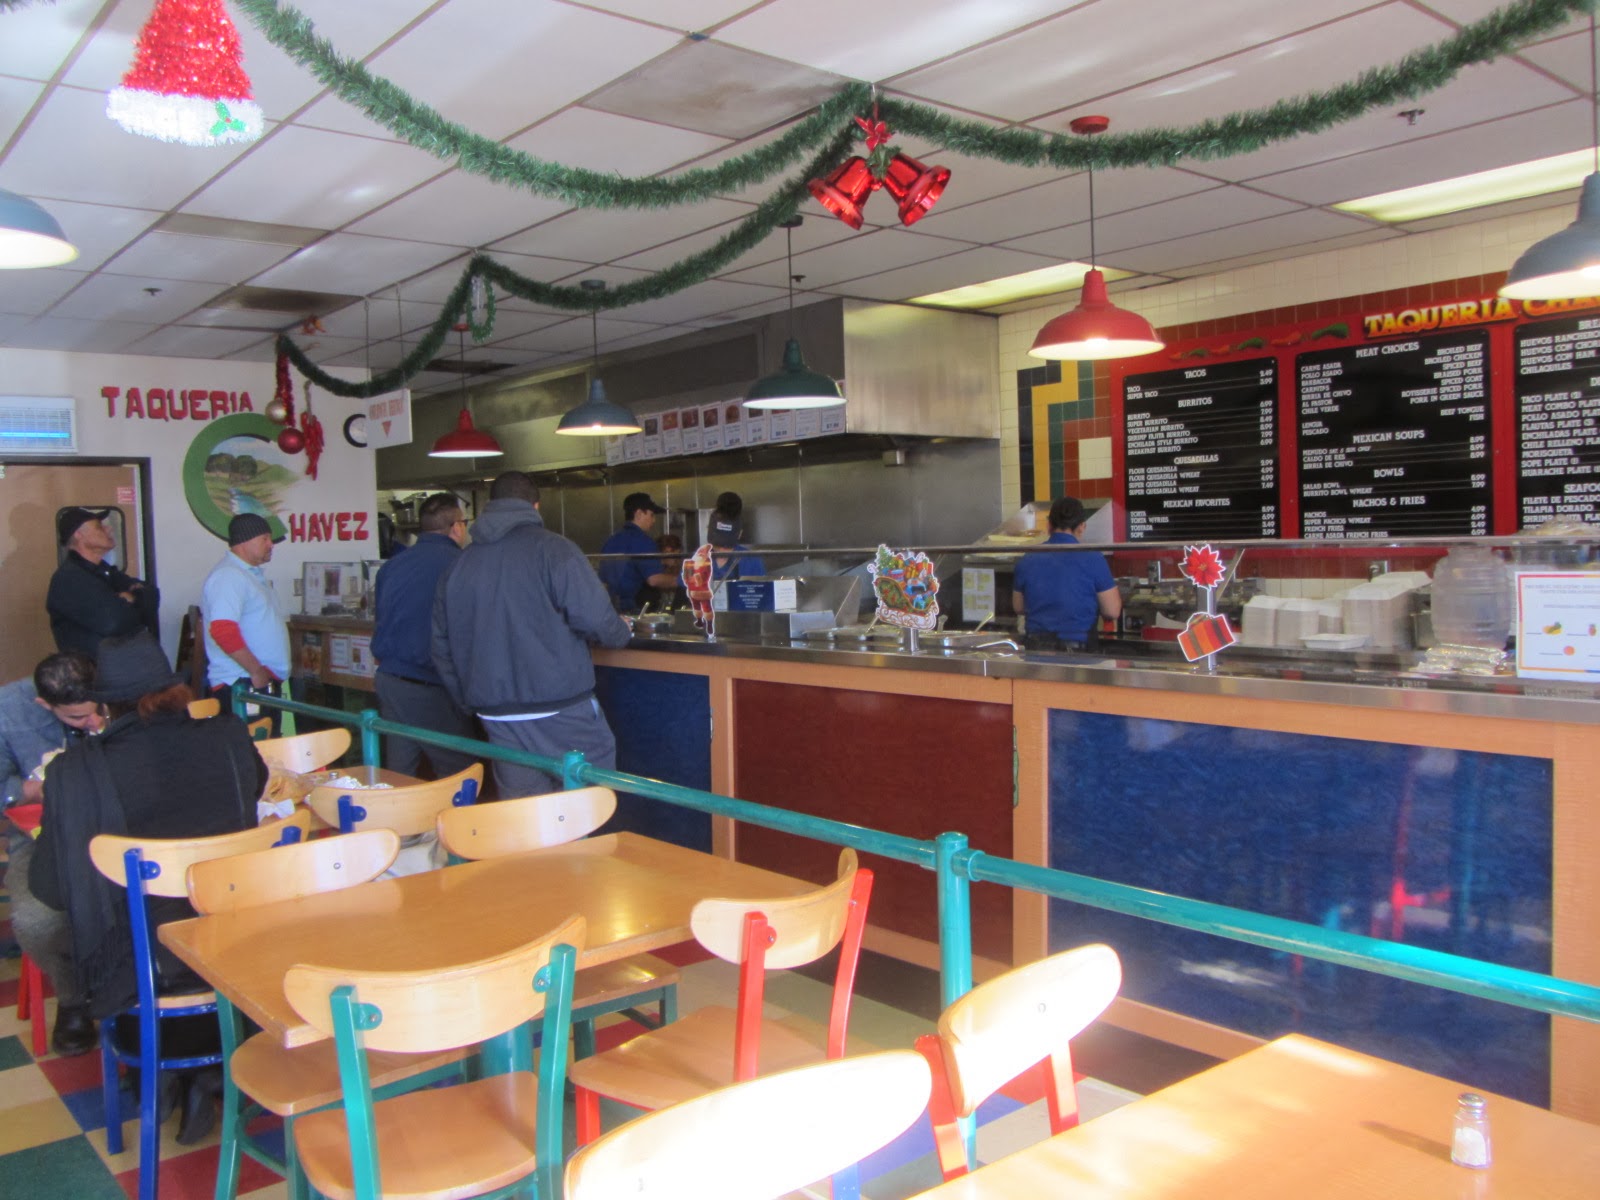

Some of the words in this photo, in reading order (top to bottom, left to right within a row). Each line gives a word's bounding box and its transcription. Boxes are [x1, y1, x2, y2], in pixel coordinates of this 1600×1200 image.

[1365, 297, 1518, 338] TAQUERIA
[1521, 336, 1553, 347] HUEVOS
[1356, 348, 1379, 358] MEAT
[1382, 342, 1419, 354] CHOICES
[1437, 346, 1464, 355] BROILED
[1467, 344, 1482, 352] BEEF
[1521, 346, 1553, 356] HUEVOS
[1555, 343, 1573, 352] CON
[1425, 355, 1451, 365] BROILED
[1453, 352, 1482, 362] CHICKEN
[1521, 355, 1553, 366] HUEVOS
[1555, 353, 1573, 361] CON
[1576, 350, 1596, 359] HAM
[1301, 364, 1320, 372] CARNE
[1322, 362, 1341, 370] ASADA
[1442, 362, 1465, 370] SPICED
[1521, 362, 1572, 375] CHILAQUILES
[1184, 369, 1206, 378] TACOS
[1301, 371, 1320, 379] POLLO
[1322, 369, 1342, 377] ASADO
[1433, 370, 1461, 379] BRAISED
[1463, 368, 1482, 376] PORK
[1302, 378, 1332, 387] BARBACOA
[1441, 377, 1463, 386] SPICED
[1465, 375, 1483, 383] GOAT
[1302, 392, 1321, 401] BIRRIA
[1333, 389, 1352, 397] CHIVO
[1402, 388, 1437, 398] ROTISSERIE
[1440, 385, 1462, 393] SPICED
[1463, 383, 1483, 391] PORK
[1178, 397, 1212, 408] BURRITOS
[1410, 396, 1428, 404] PORK
[1439, 393, 1461, 401] GREEN
[1463, 391, 1483, 399] SAUCE
[1521, 395, 1542, 403] TACO
[1544, 392, 1568, 402] PLATE
[101, 386, 253, 422] TAQUERIA
[1311, 399, 1332, 407] PASTOR
[1522, 404, 1542, 413] MEAT
[1545, 401, 1576, 411] COMBO
[1302, 406, 1318, 415] CHILE
[1440, 408, 1456, 416] BEEF
[1458, 406, 1484, 415] TONGUE
[1522, 413, 1548, 421] POLLO
[1551, 411, 1579, 419] ASADO
[1145, 418, 1168, 426] BURRITO
[1302, 421, 1323, 429] LENGUA
[1522, 422, 1554, 431] FLAUTAS
[1557, 419, 1581, 428] PLATE
[1128, 426, 1158, 434] VEGETARIAN
[1302, 428, 1329, 436] PESCADO
[1522, 430, 1570, 440] ENCHILADAS
[1573, 428, 1597, 437] PLATE
[1353, 432, 1392, 444] MEXICAN
[1395, 430, 1425, 441] SOUPS
[1522, 441, 1545, 449] CHILE
[1547, 439, 1583, 447] RELLENO
[1128, 447, 1156, 455] BREAKFAST
[1302, 448, 1327, 456] MENUDO
[1522, 448, 1573, 458] MORISQUETA
[1174, 454, 1219, 464] QUESADILLAS
[1522, 460, 1542, 468] SOPE
[1545, 458, 1568, 466] PLATE
[1303, 462, 1323, 470] BIRRIA
[1374, 468, 1404, 478] BOWLS
[1522, 467, 1564, 477] HUARACHE
[1567, 466, 1591, 474] PLATE
[1303, 489, 1328, 497] BURRITO
[1163, 500, 1193, 508] MEXICAN
[1195, 498, 1230, 507] FAVORITES
[1353, 498, 1387, 508] NACHOS
[1390, 498, 1397, 506] &
[1400, 496, 1426, 505] FRIES
[1523, 506, 1554, 514] TILAPIA
[1328, 524, 1344, 532] FRIES
